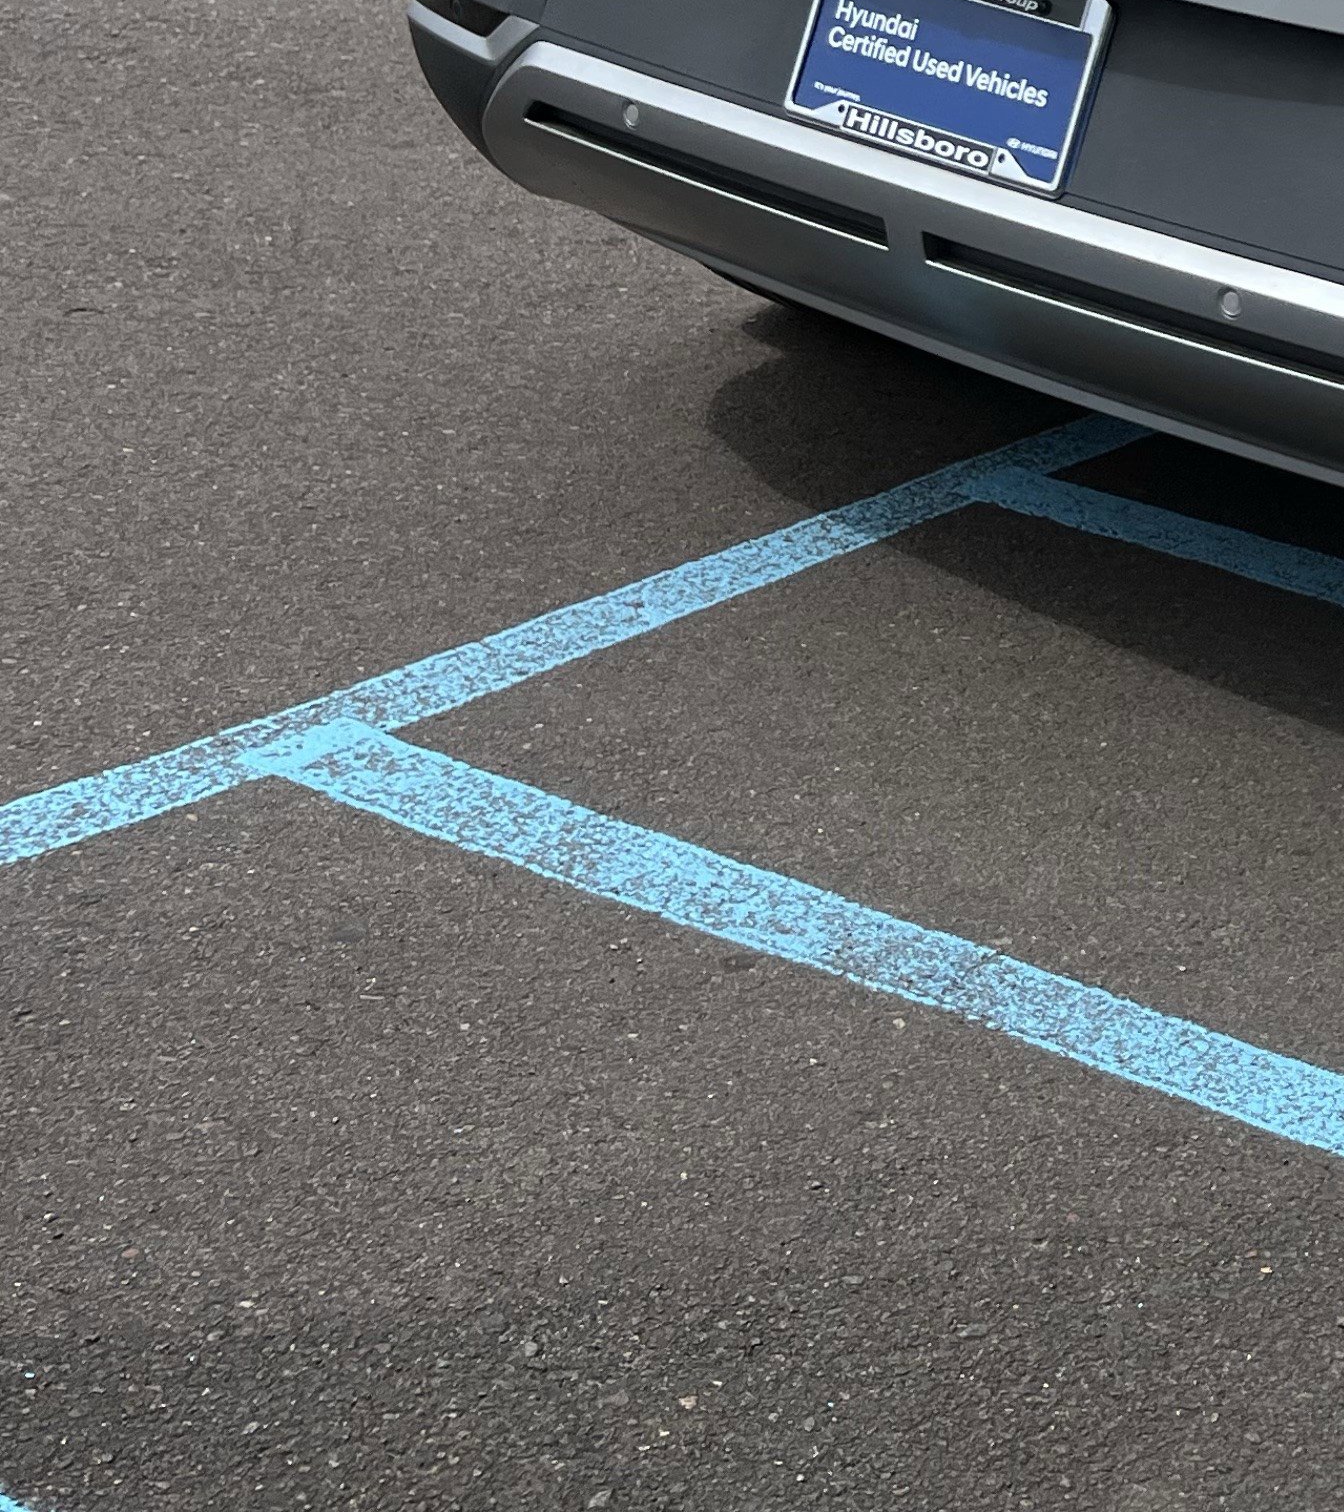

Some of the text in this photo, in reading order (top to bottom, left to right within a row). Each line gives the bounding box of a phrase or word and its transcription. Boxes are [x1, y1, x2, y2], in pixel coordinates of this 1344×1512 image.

[828, 26, 1049, 108] Certified Used Vehicles
[848, 107, 990, 168] Hillsboro
